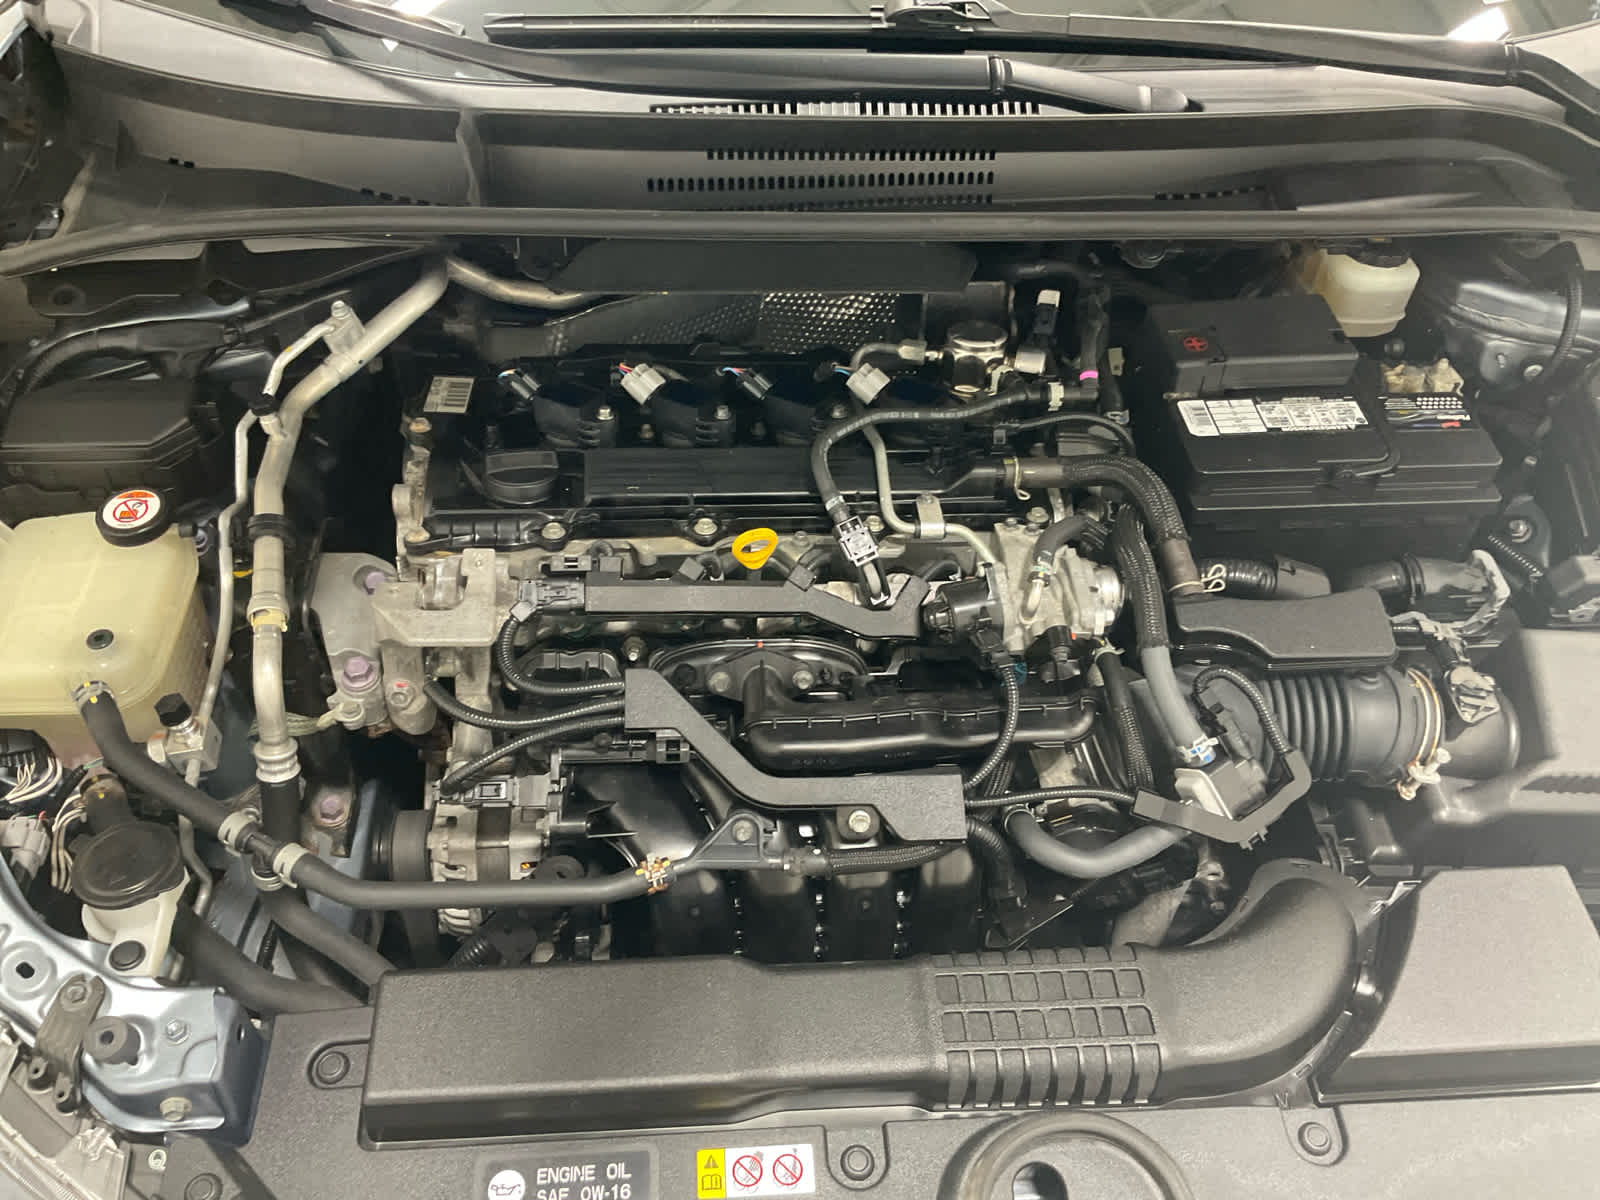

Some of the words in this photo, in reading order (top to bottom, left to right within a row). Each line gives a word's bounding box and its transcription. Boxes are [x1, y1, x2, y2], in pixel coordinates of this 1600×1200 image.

[537, 1164, 596, 1185] ENGINE
[606, 1162, 632, 1180] OIL
[580, 1183, 631, 1200] 0W-16
